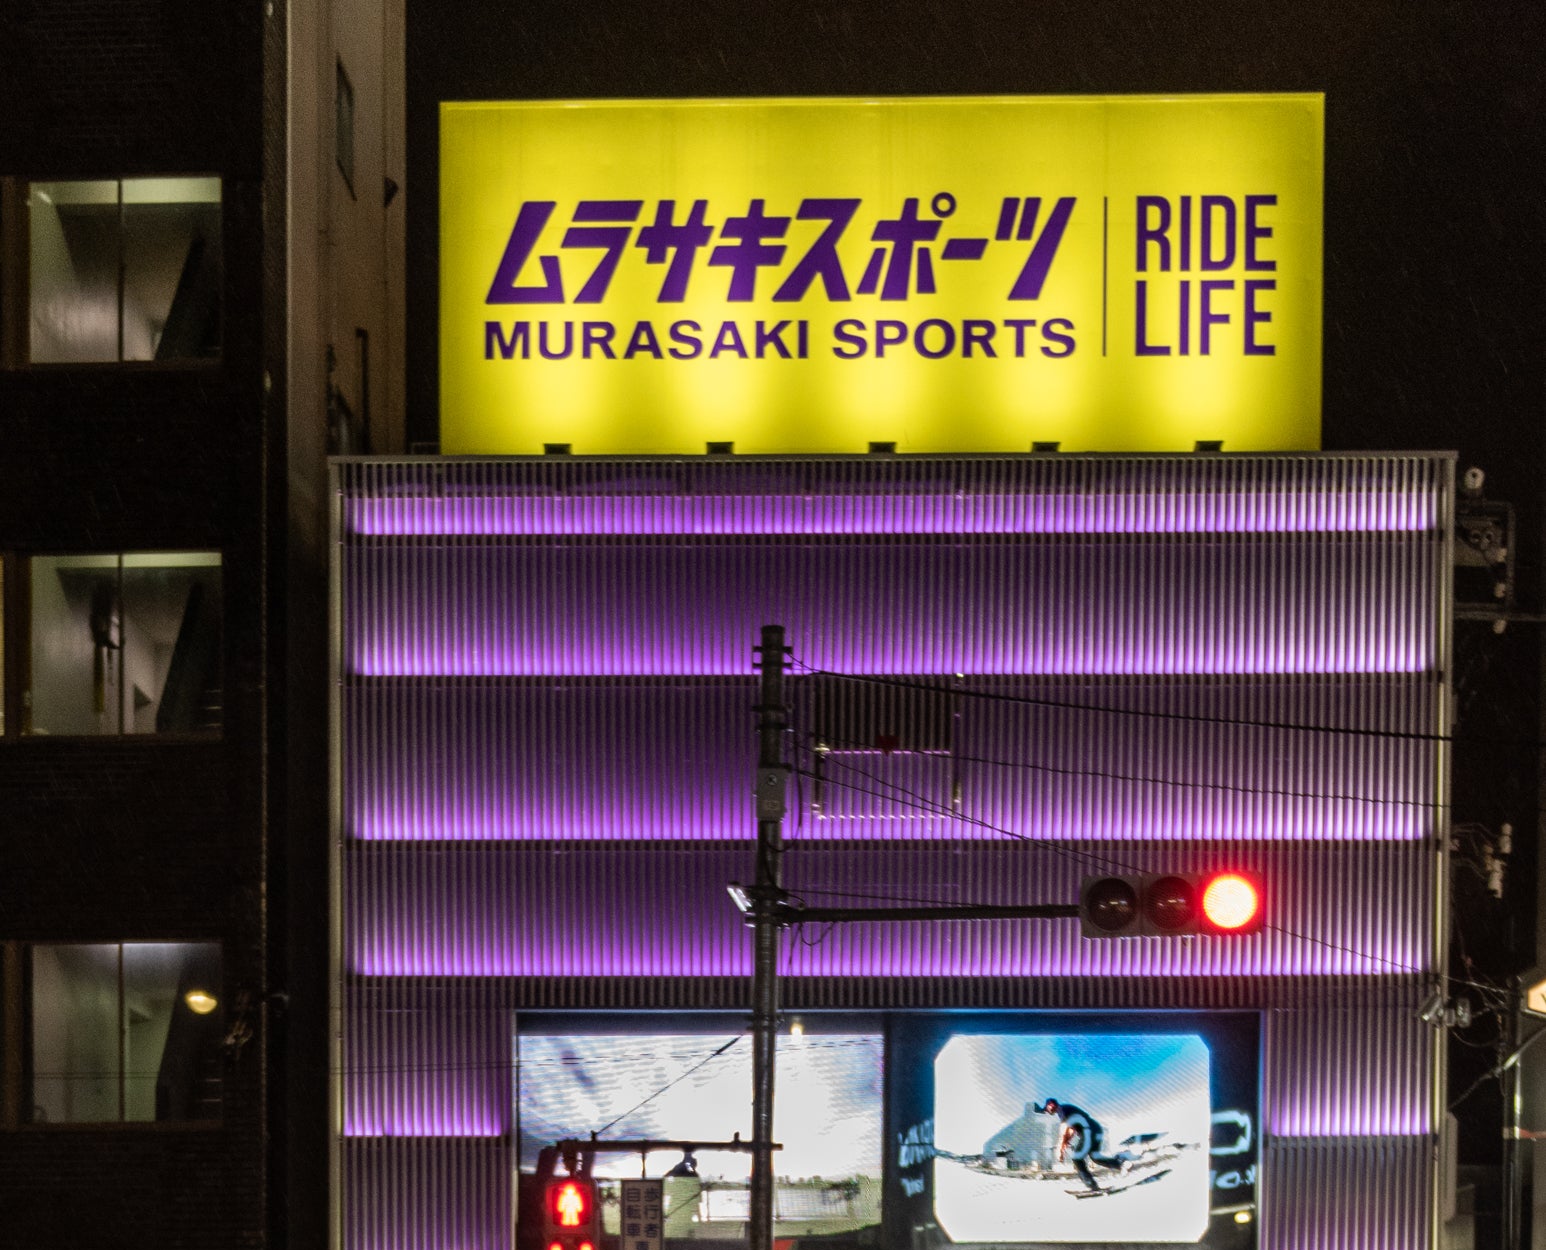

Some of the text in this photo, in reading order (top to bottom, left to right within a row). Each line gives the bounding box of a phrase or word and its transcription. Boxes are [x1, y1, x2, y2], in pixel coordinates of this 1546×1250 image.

[486, 192, 1076, 304] ムラサキスポーツ
[1136, 194, 1277, 272] RIDE
[484, 318, 1077, 360] MURASAKI SPORTS
[1135, 279, 1277, 357] LIFE
